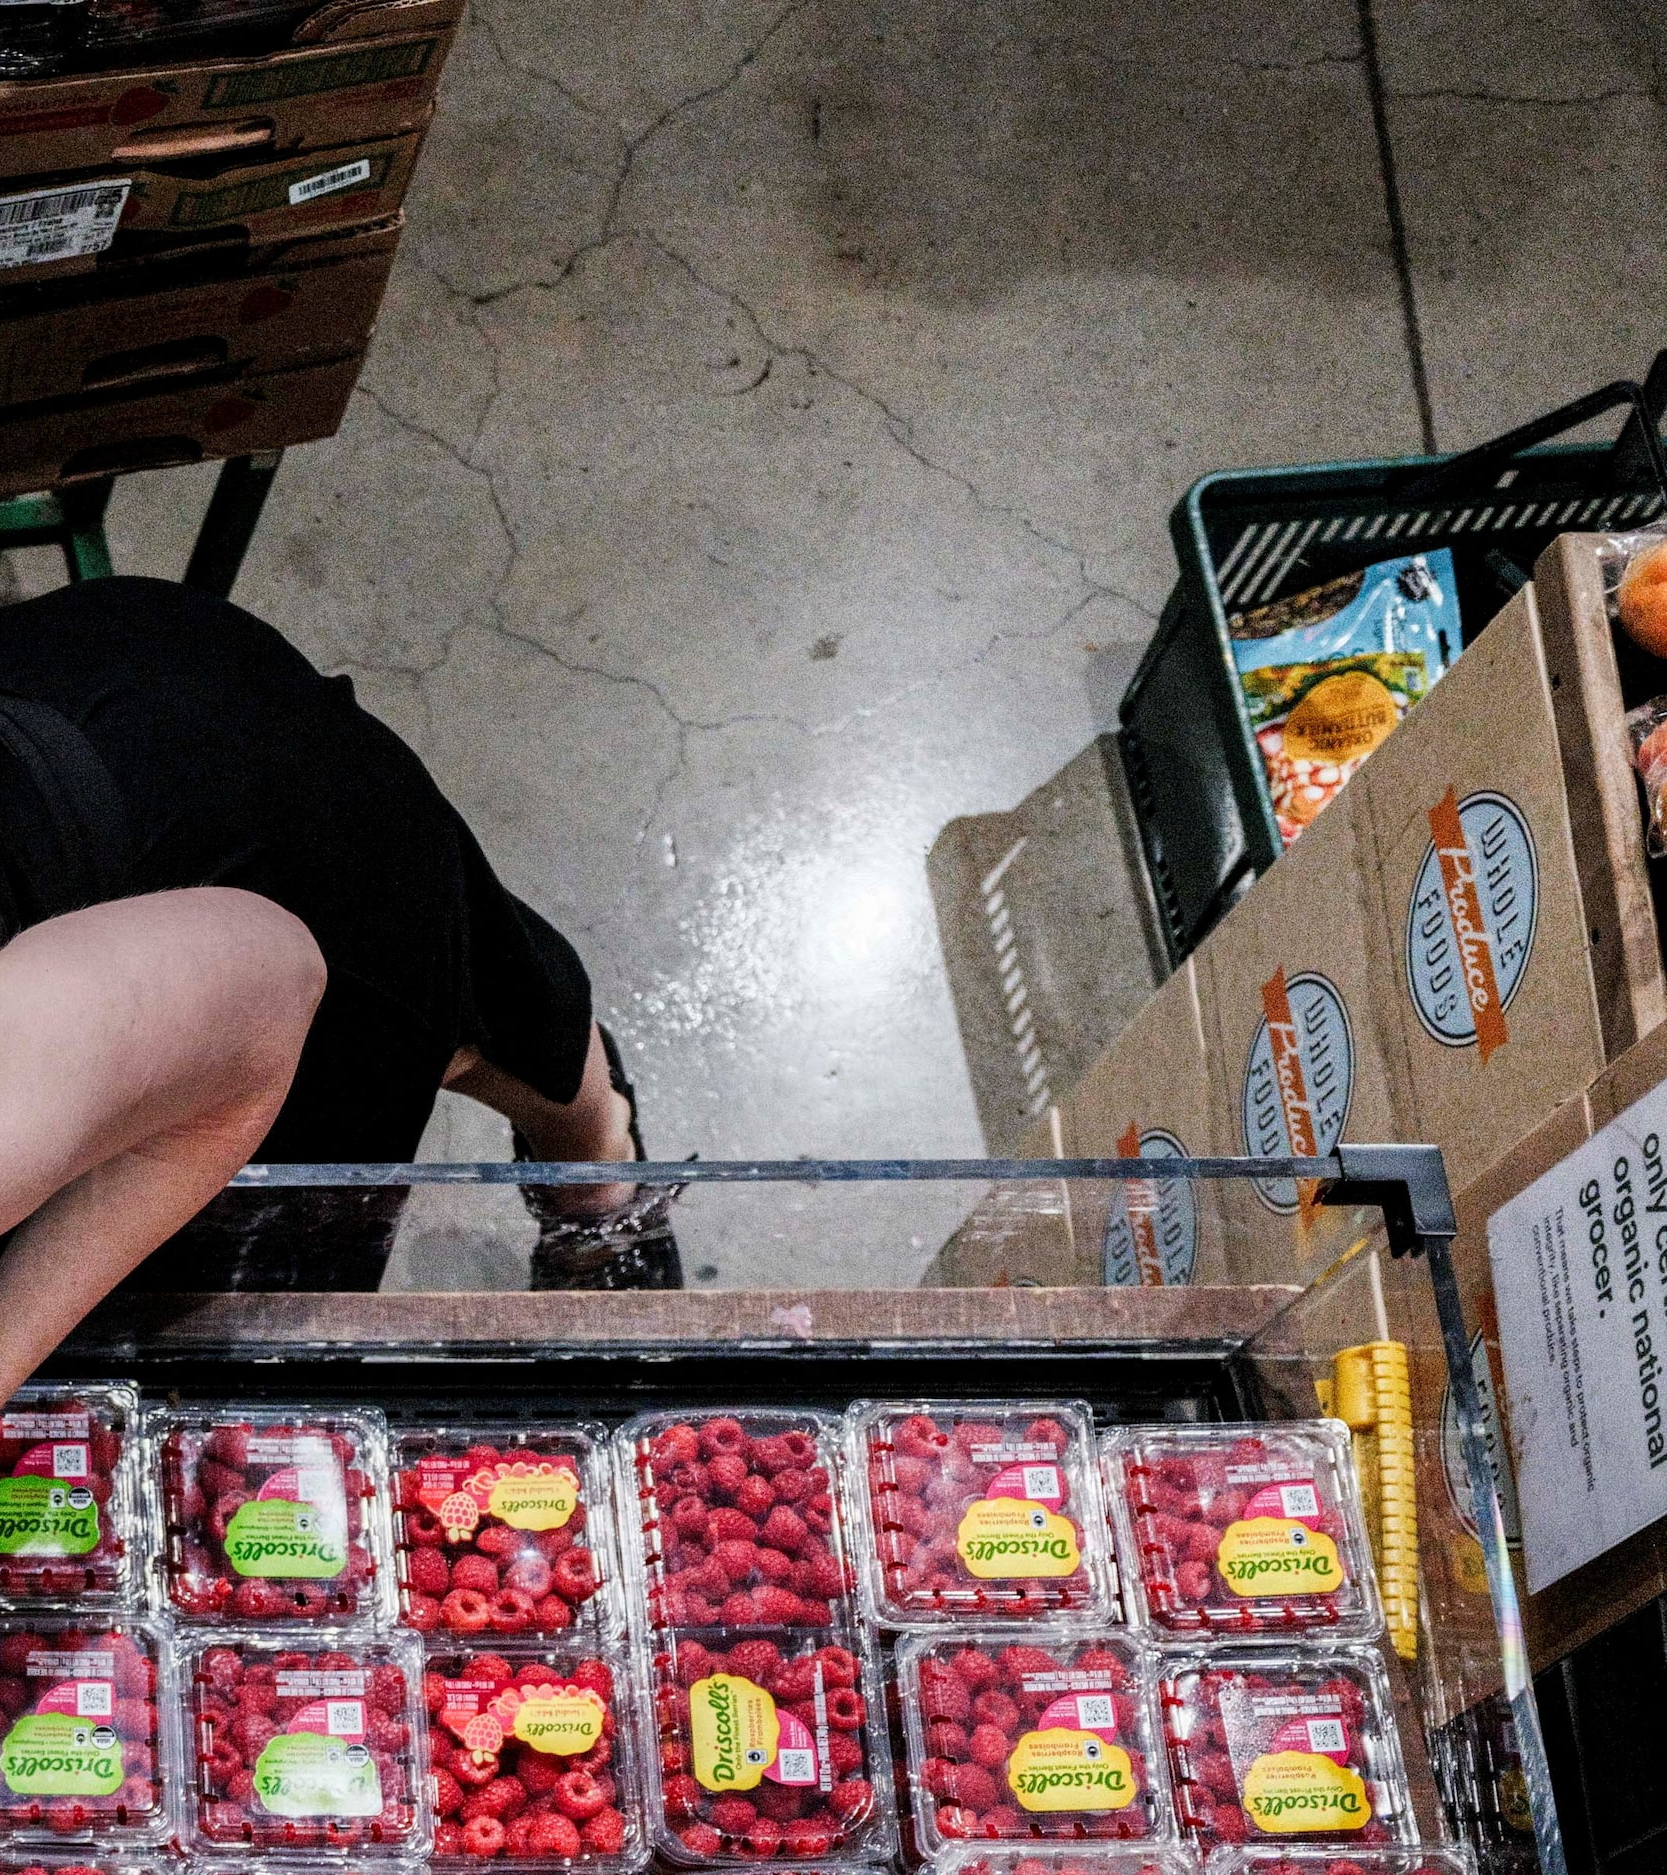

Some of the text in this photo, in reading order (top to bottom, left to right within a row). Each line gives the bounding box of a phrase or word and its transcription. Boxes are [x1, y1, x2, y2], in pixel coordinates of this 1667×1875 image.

[1481, 816, 1524, 968] WHOLE
[1439, 838, 1495, 1012] Produce
[1417, 887, 1458, 1022] FOODS
[1304, 996, 1342, 1136] WHOLE
[1553, 1206, 1566, 1237] That
[1533, 1225, 1549, 1308] conventional
[1557, 1239, 1570, 1281] means
[1579, 1178, 1614, 1320] grocer.
[1566, 1305, 1579, 1336] take
[1614, 1156, 1667, 1470] organic national
[1554, 1300, 1570, 1370] separating
[1563, 1371, 1577, 1422] organic
[1568, 1338, 1583, 1372] steps
[1576, 1392, 1591, 1441] protect
[1582, 1441, 1595, 1492] organic
[498, 1496, 567, 1514] Driscoll's
[966, 1539, 1071, 1560] Driscoll's
[1225, 1558, 1333, 1579] Driscoll's
[526, 1722, 592, 1737] Driscoll's
[710, 1676, 734, 1784] Driscoll's
[8, 1757, 113, 1777] Driscoll's
[1018, 1769, 1126, 1793] Driscoll's
[1251, 1791, 1362, 1815] Driscoll's
